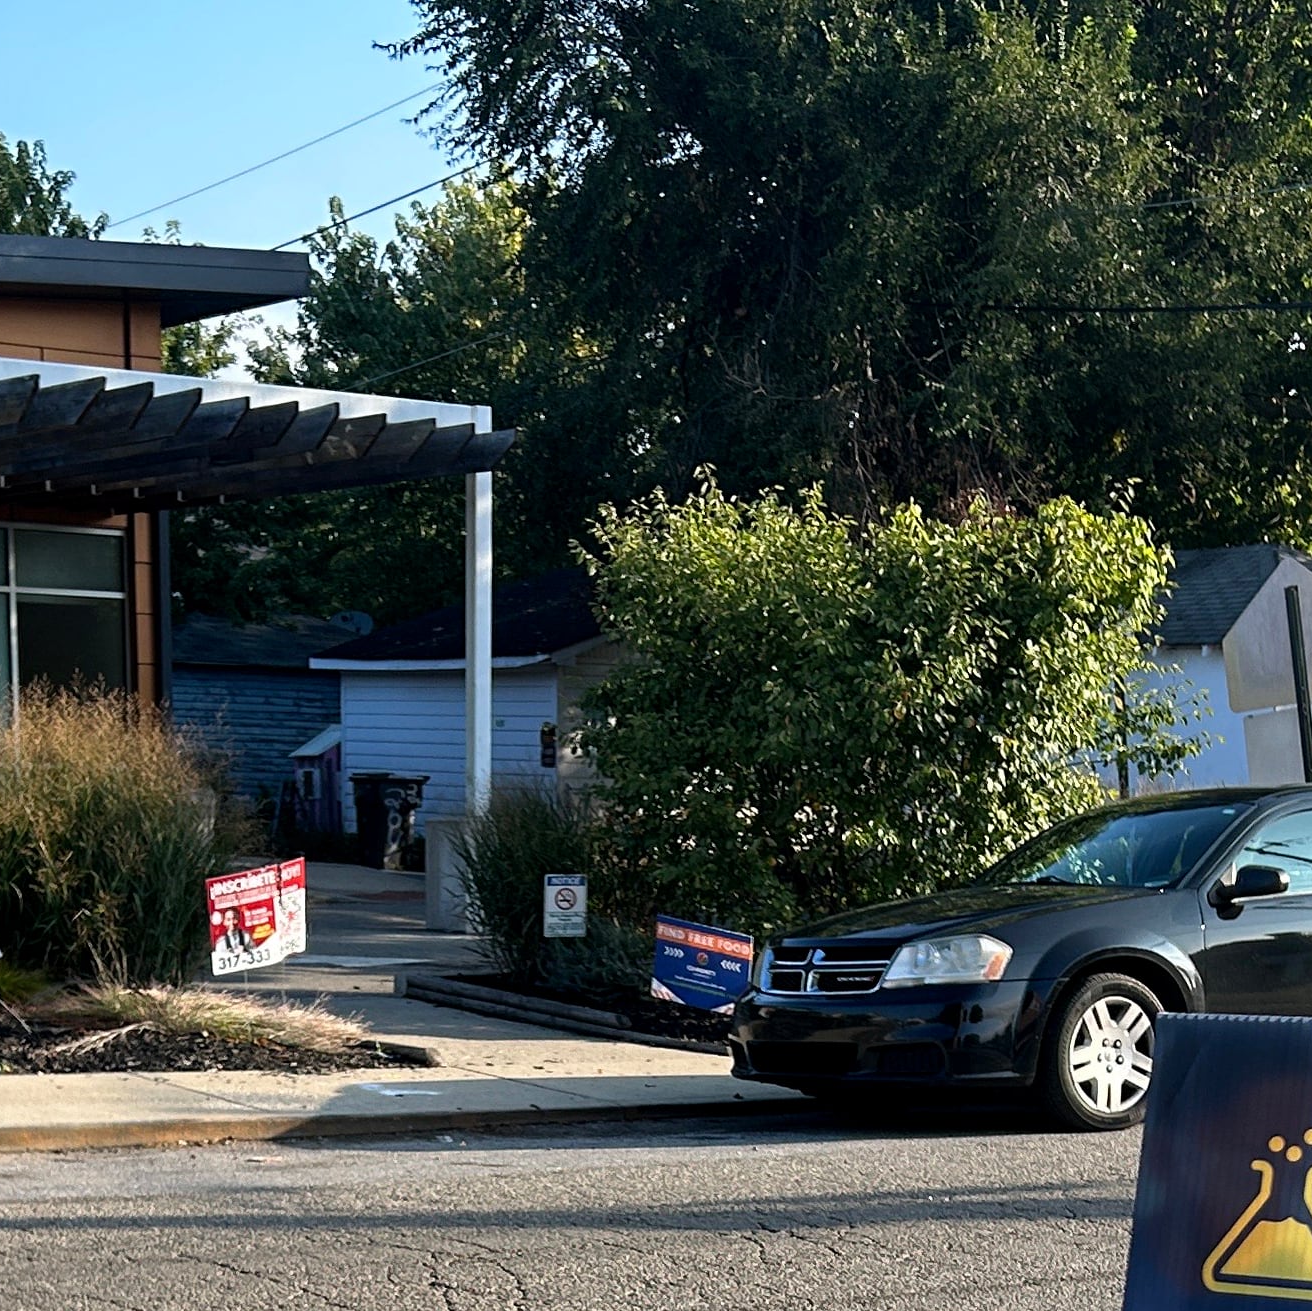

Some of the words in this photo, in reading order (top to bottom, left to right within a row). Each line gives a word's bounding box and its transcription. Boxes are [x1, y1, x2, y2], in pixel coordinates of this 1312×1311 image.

[657, 925, 685, 939] FIND
[687, 933, 714, 947] FREE
[716, 940, 750, 955] FOOD
